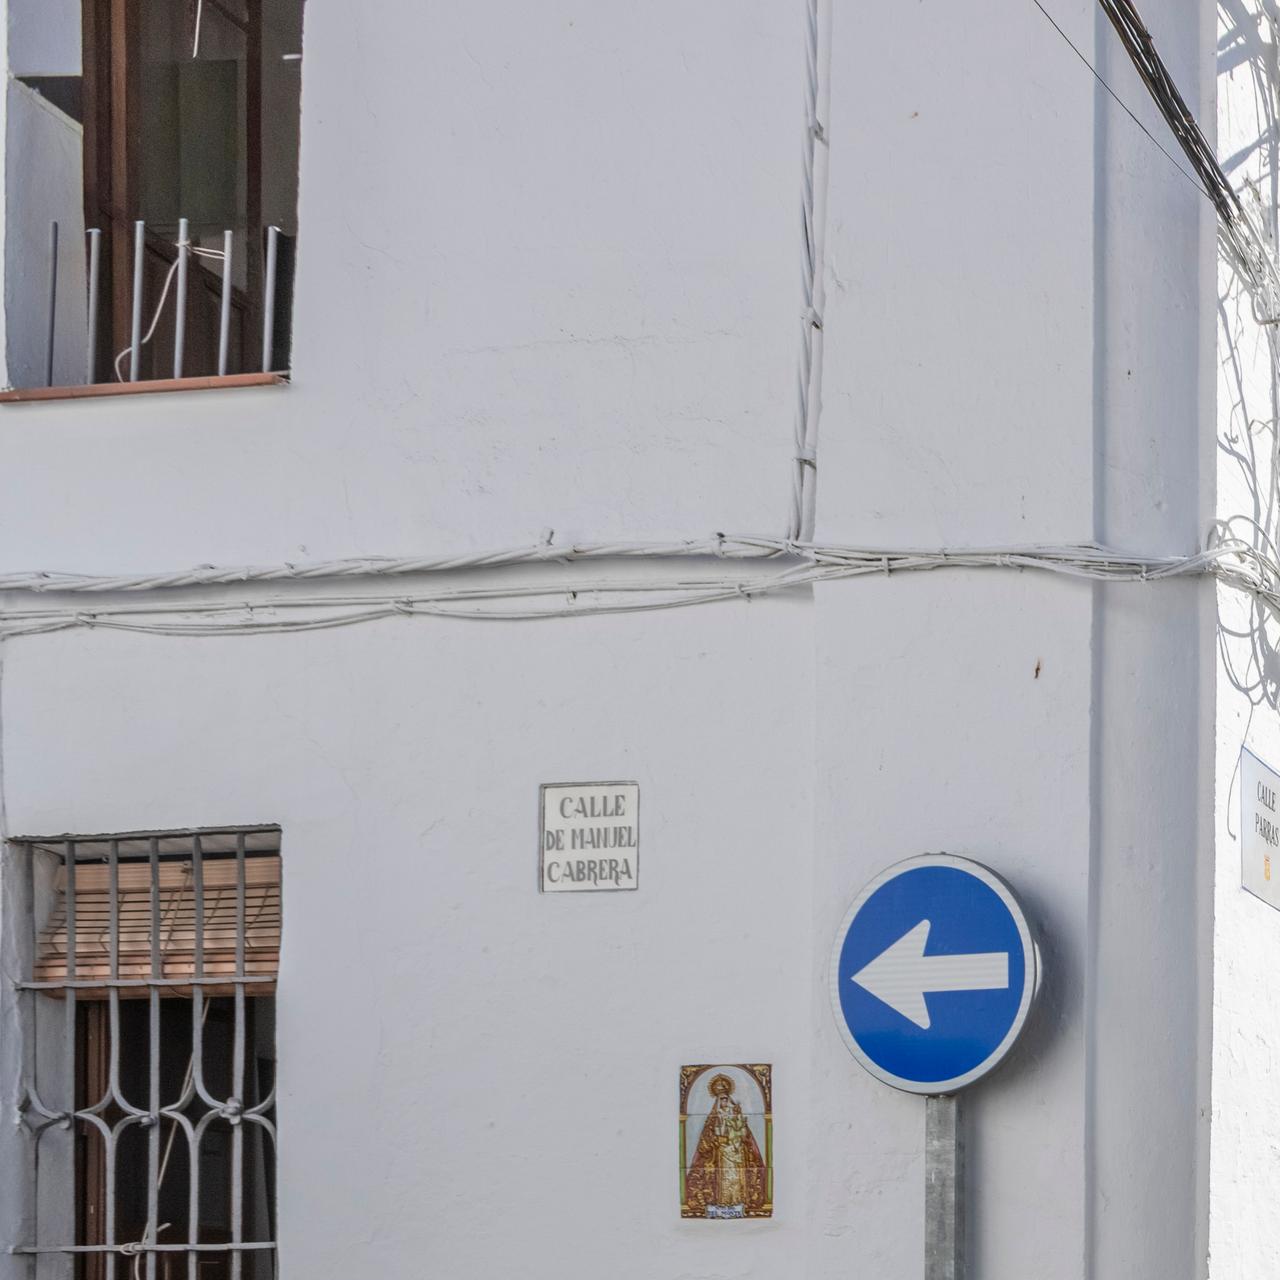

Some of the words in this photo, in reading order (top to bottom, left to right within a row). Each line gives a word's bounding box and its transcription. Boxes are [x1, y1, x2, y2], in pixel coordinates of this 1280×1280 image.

[559, 794, 626, 819] CALLE
[1256, 780, 1276, 813] CALLE
[545, 828, 565, 851] DE
[570, 825, 637, 850] MANUEL
[1254, 812, 1280, 848] PARRAS
[547, 857, 633, 887] CABRERA
